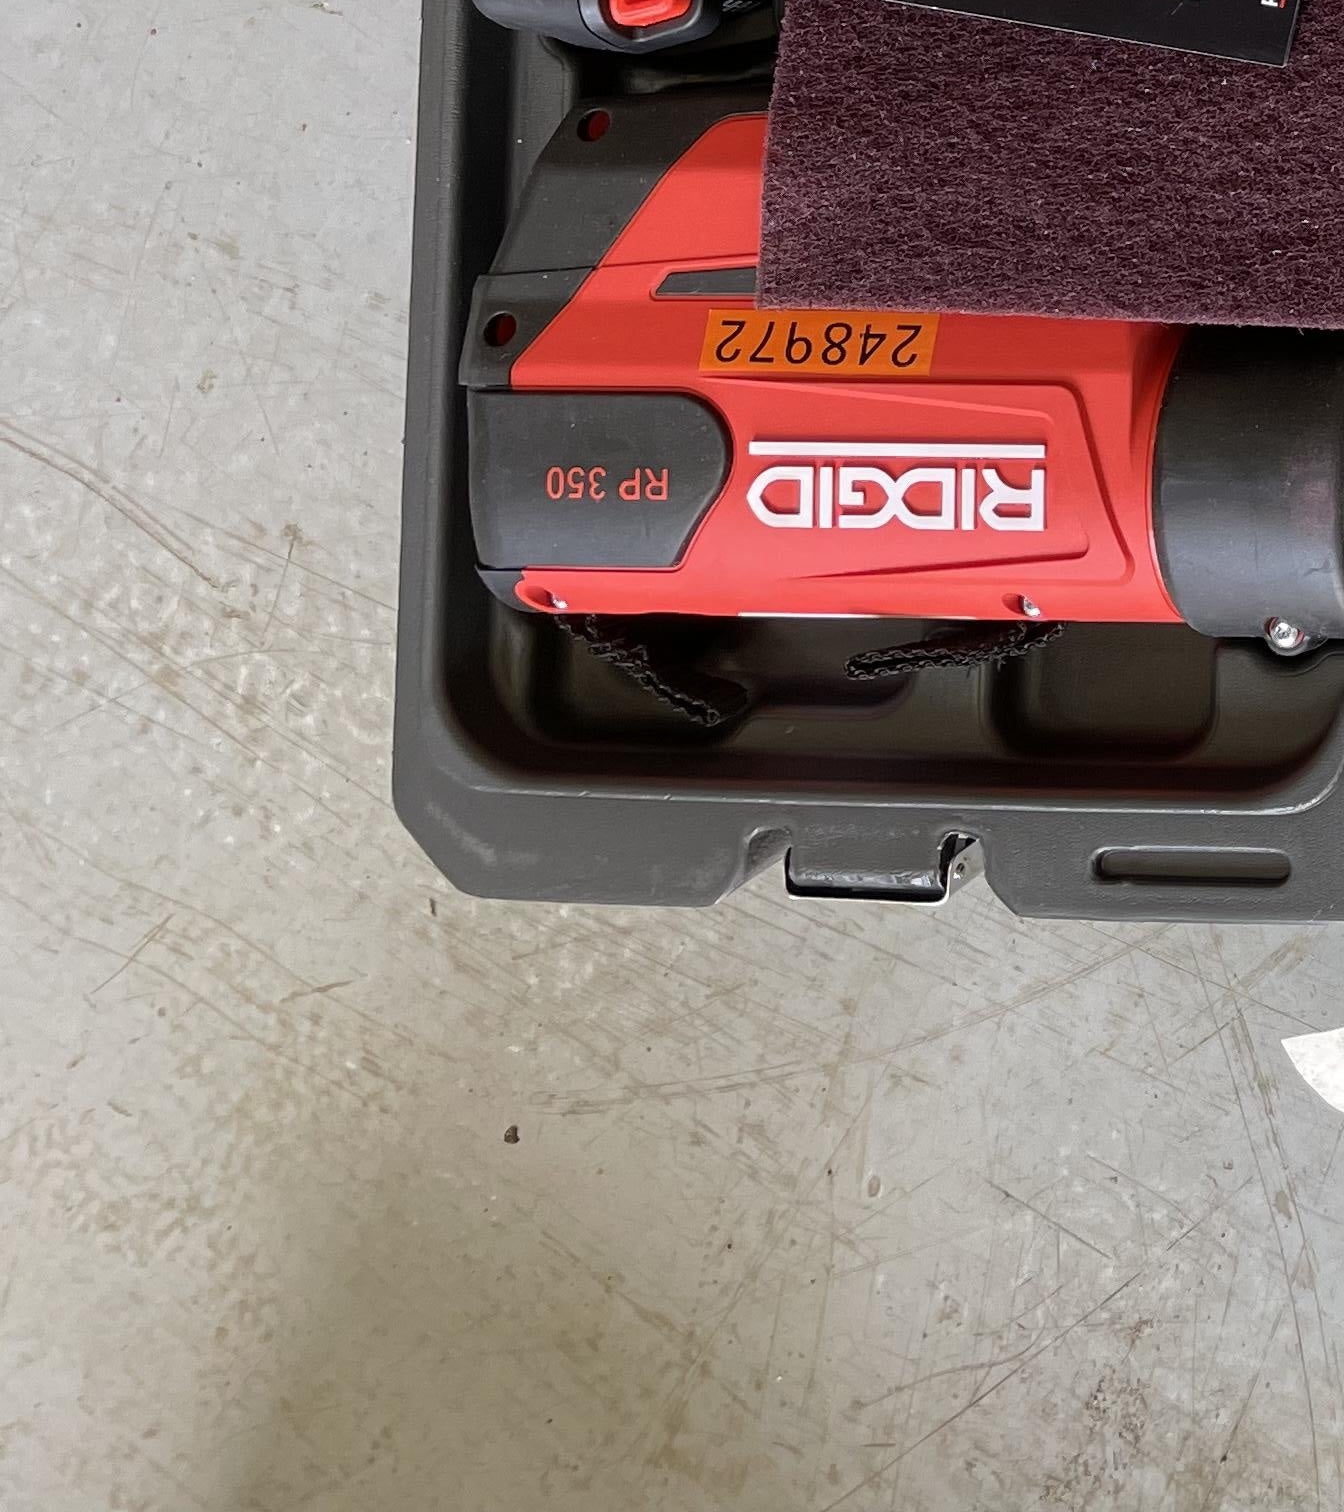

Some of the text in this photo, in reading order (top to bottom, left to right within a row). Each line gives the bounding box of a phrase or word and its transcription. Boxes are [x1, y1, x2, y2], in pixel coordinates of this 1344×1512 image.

[715, 318, 922, 368] 248972
[546, 466, 669, 501] RP 350
[746, 464, 1045, 532] RIDGID
